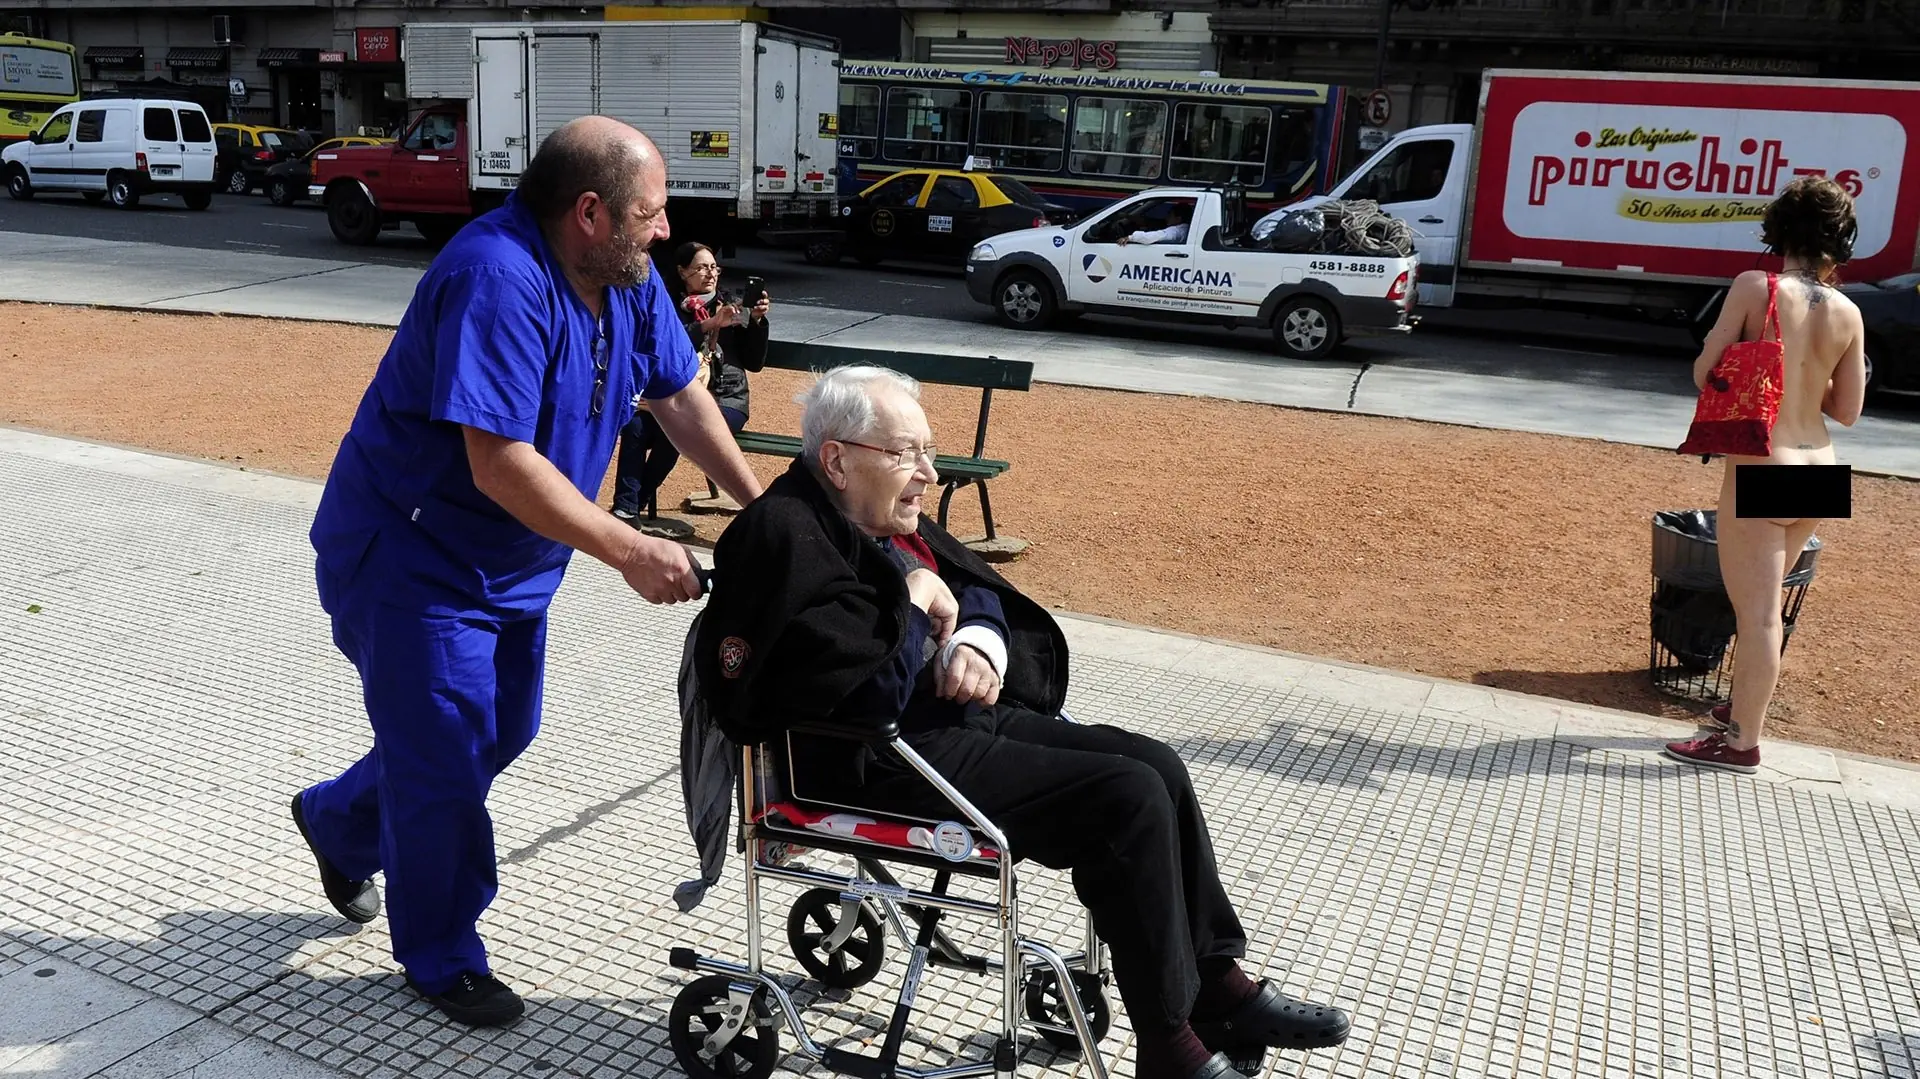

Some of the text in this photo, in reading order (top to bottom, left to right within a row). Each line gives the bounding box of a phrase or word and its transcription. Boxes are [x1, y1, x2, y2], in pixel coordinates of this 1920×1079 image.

[321, 53, 342, 61] HOSTEL
[905, 67, 949, 80] ONCE
[961, 69, 1026, 86] 64
[1076, 75, 1098, 88] DE
[1105, 76, 1154, 90] MAYO
[1169, 79, 1190, 91] LA
[1199, 81, 1246, 96] BOCA
[775, 84, 785, 100] 80
[1596, 128, 1626, 148] Las
[842, 144, 853, 153] 64
[1627, 199, 1652, 218] 50
[1653, 203, 1697, 218] Años
[1701, 204, 1720, 218] de
[1309, 261, 1385, 273] 4581-8888
[1119, 264, 1233, 288] AMERICANA
[1197, 286, 1233, 297] Pinturas
